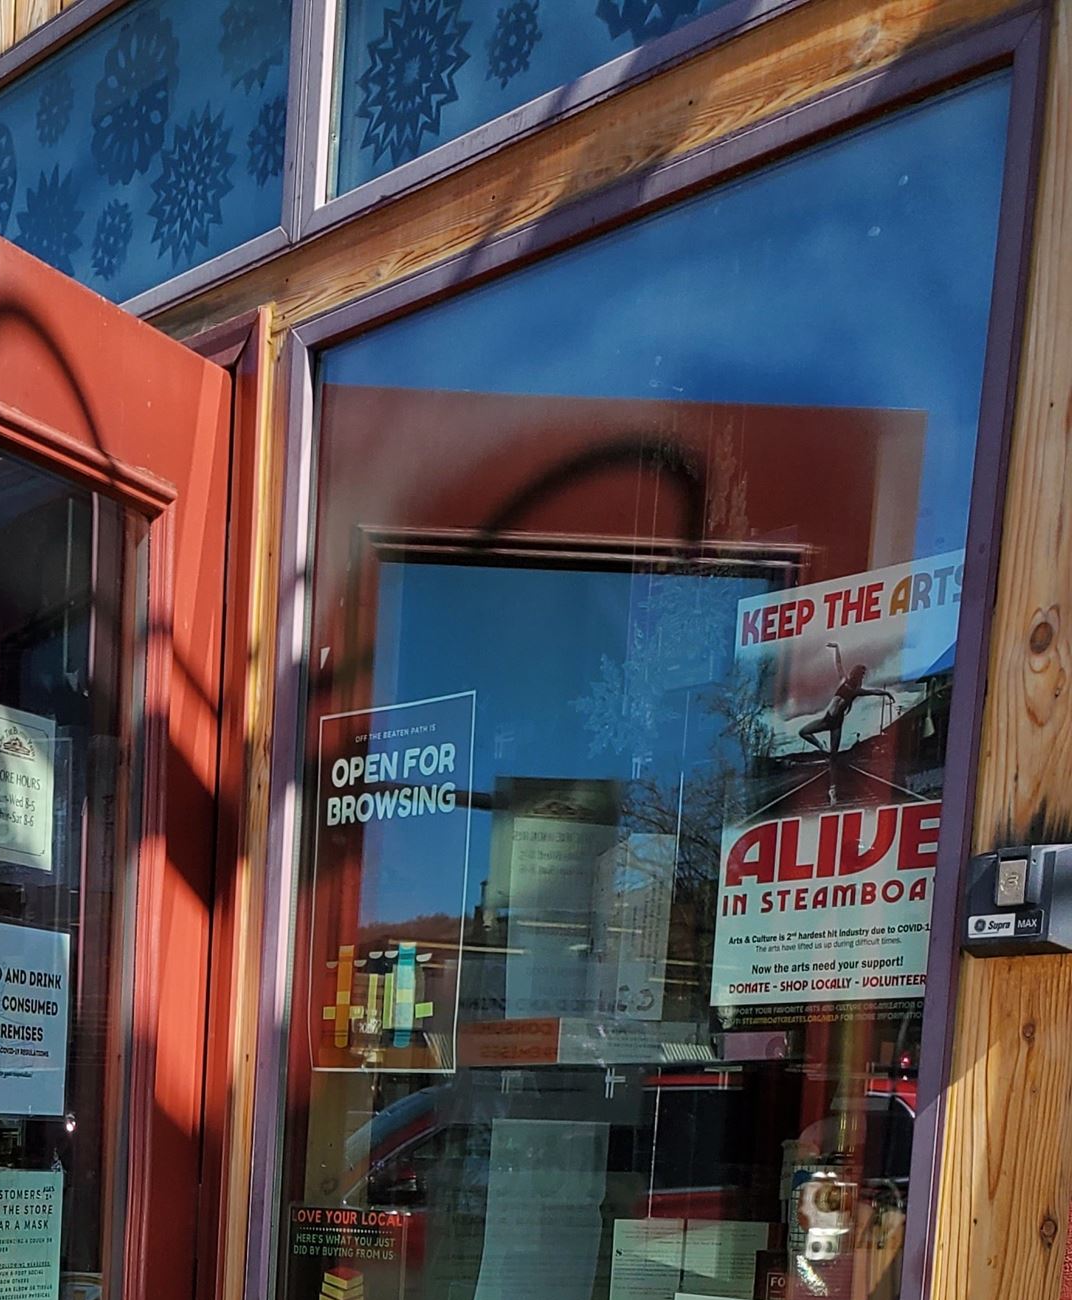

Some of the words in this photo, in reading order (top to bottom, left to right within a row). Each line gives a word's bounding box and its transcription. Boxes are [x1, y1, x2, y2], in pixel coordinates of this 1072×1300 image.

[741, 598, 815, 647] KEEP
[824, 582, 884, 629] THE
[355, 734, 368, 743] OFF
[369, 732, 381, 740] THE
[383, 728, 409, 739] BEATEN
[410, 725, 428, 735] PATH
[429, 723, 436, 731] IS
[332, 751, 398, 788] OPEN
[403, 743, 456, 779] FOR
[16, 773, 41, 791] HOURS
[327, 782, 456, 826] BROWSING
[725, 802, 942, 887] ALIVE
[722, 893, 747, 917] IN
[761, 877, 932, 914] STEAMBOA
[728, 937, 743, 945] Arts
[744, 936, 750, 944] &
[752, 935, 777, 943] Culture
[779, 933, 785, 941] is
[798, 930, 826, 940] hardest
[827, 929, 837, 938] hit
[839, 927, 869, 937] Industry
[871, 926, 886, 935] due
[887, 926, 896, 934] to
[897, 923, 931, 933] COVID-1
[988, 920, 1010, 932] Supra
[1017, 919, 1038, 928] MAX
[798, 942, 813, 950] lifted
[833, 940, 854, 949] during
[855, 938, 880, 946] difficult
[752, 963, 771, 975] Now
[774, 961, 789, 973] the
[792, 962, 810, 973] arts
[812, 959, 836, 971] need
[838, 959, 859, 972] your
[861, 956, 904, 970] support!
[5, 968, 26, 984] AND
[29, 971, 62, 989] DRINK
[729, 982, 771, 994] DONATE
[780, 979, 809, 992] SHOP
[811, 977, 852, 990] LOCALLY
[862, 974, 928, 987] VOLUNTEER
[2, 995, 59, 1016] CONSUMED
[2, 1205, 20, 1215] THE
[24, 1204, 53, 1215] STORE
[292, 1209, 323, 1223] LOVE
[325, 1210, 357, 1225] YOUR
[362, 1211, 403, 1227] LOCAL
[14, 1220, 20, 1230] A
[24, 1220, 49, 1230] MASK
[296, 1233, 324, 1244] HERE'S
[325, 1234, 352, 1246] WHAT
[354, 1236, 373, 1246] YOU
[374, 1237, 396, 1248] JUST
[309, 1245, 320, 1255] BY
[322, 1246, 354, 1257] BUYING
[356, 1248, 380, 1259] FROM
[382, 1250, 394, 1260] US
